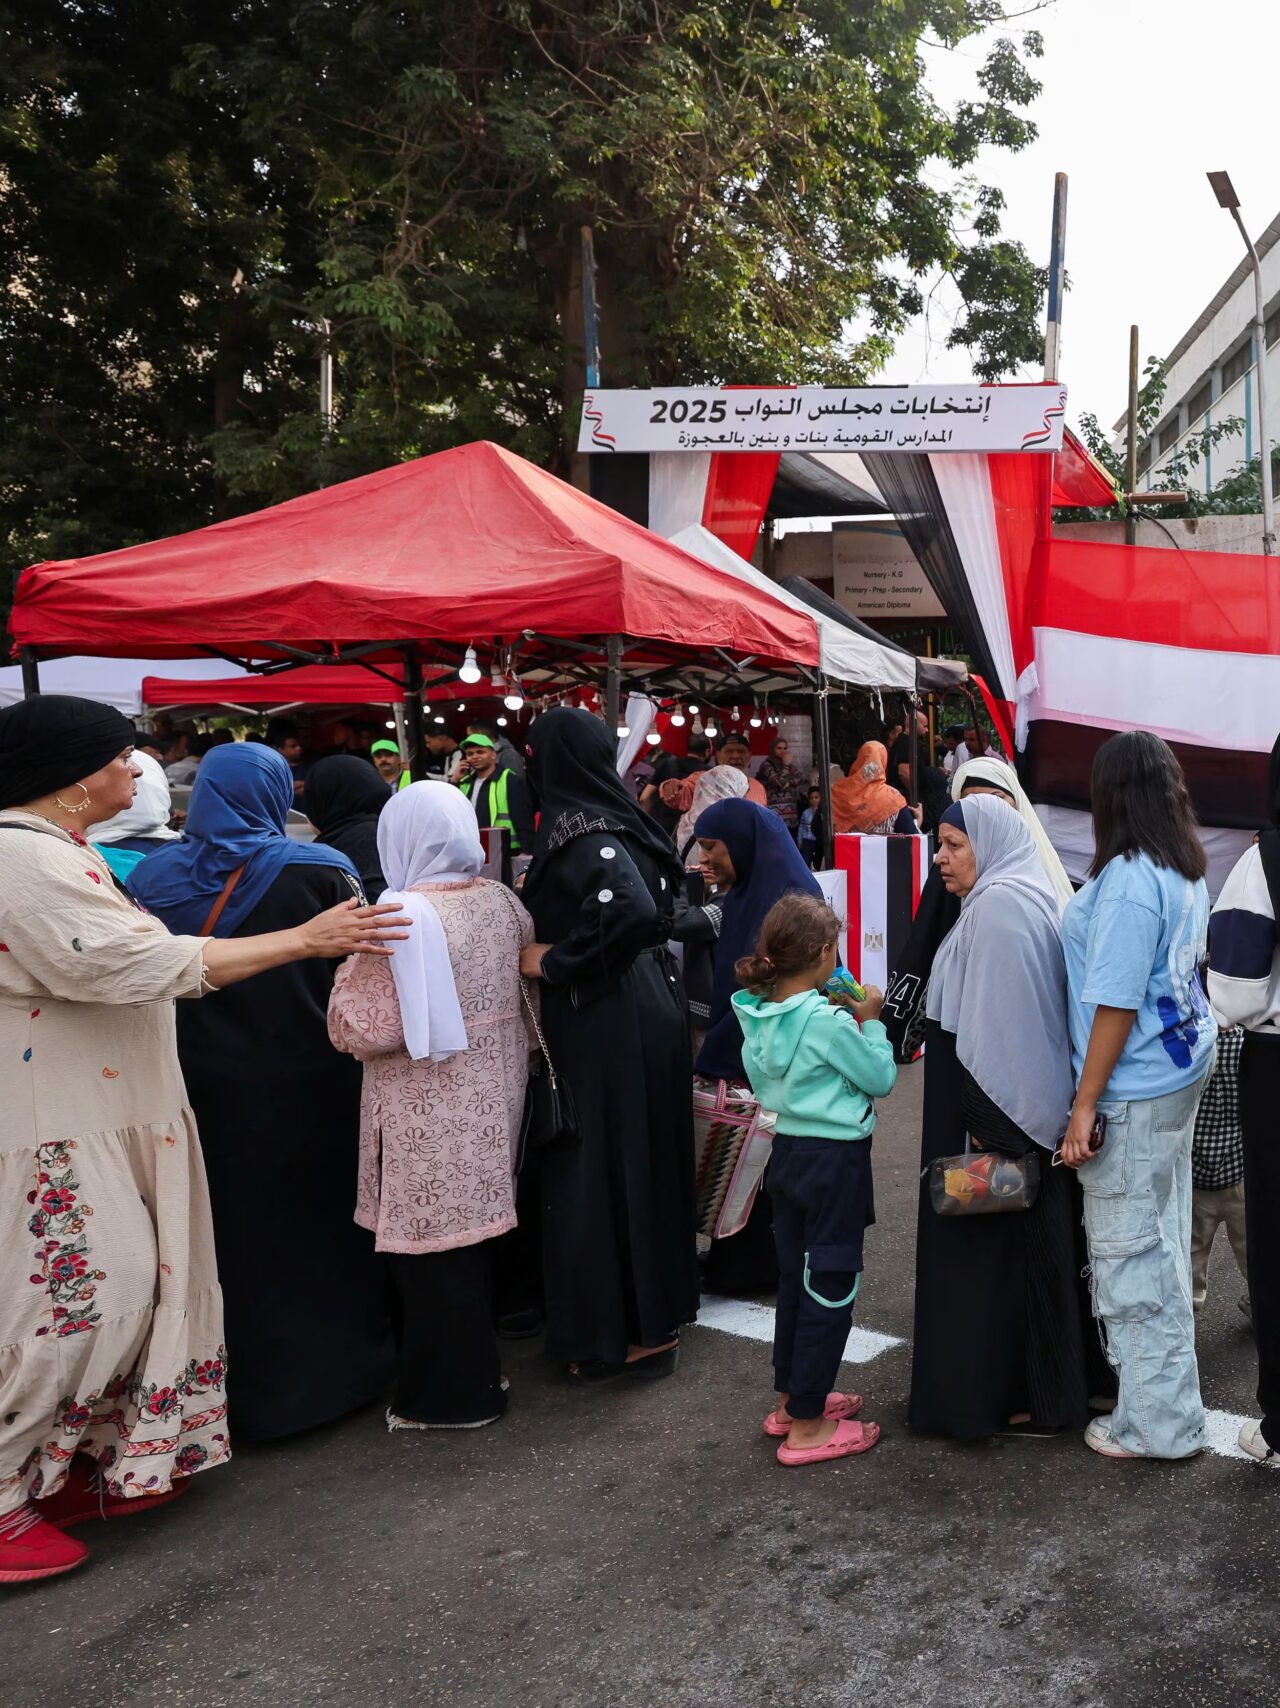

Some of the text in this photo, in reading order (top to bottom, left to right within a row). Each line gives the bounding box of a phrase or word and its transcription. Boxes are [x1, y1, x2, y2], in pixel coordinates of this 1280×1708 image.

[649, 394, 992, 423] إنتخابات مجلس النواب 2025
[677, 427, 953, 447] المدارس القومية بنات و بنين بالعجوزة
[844, 586, 923, 595] Primary Prep Secondary
[857, 601, 911, 610] American Diploma
